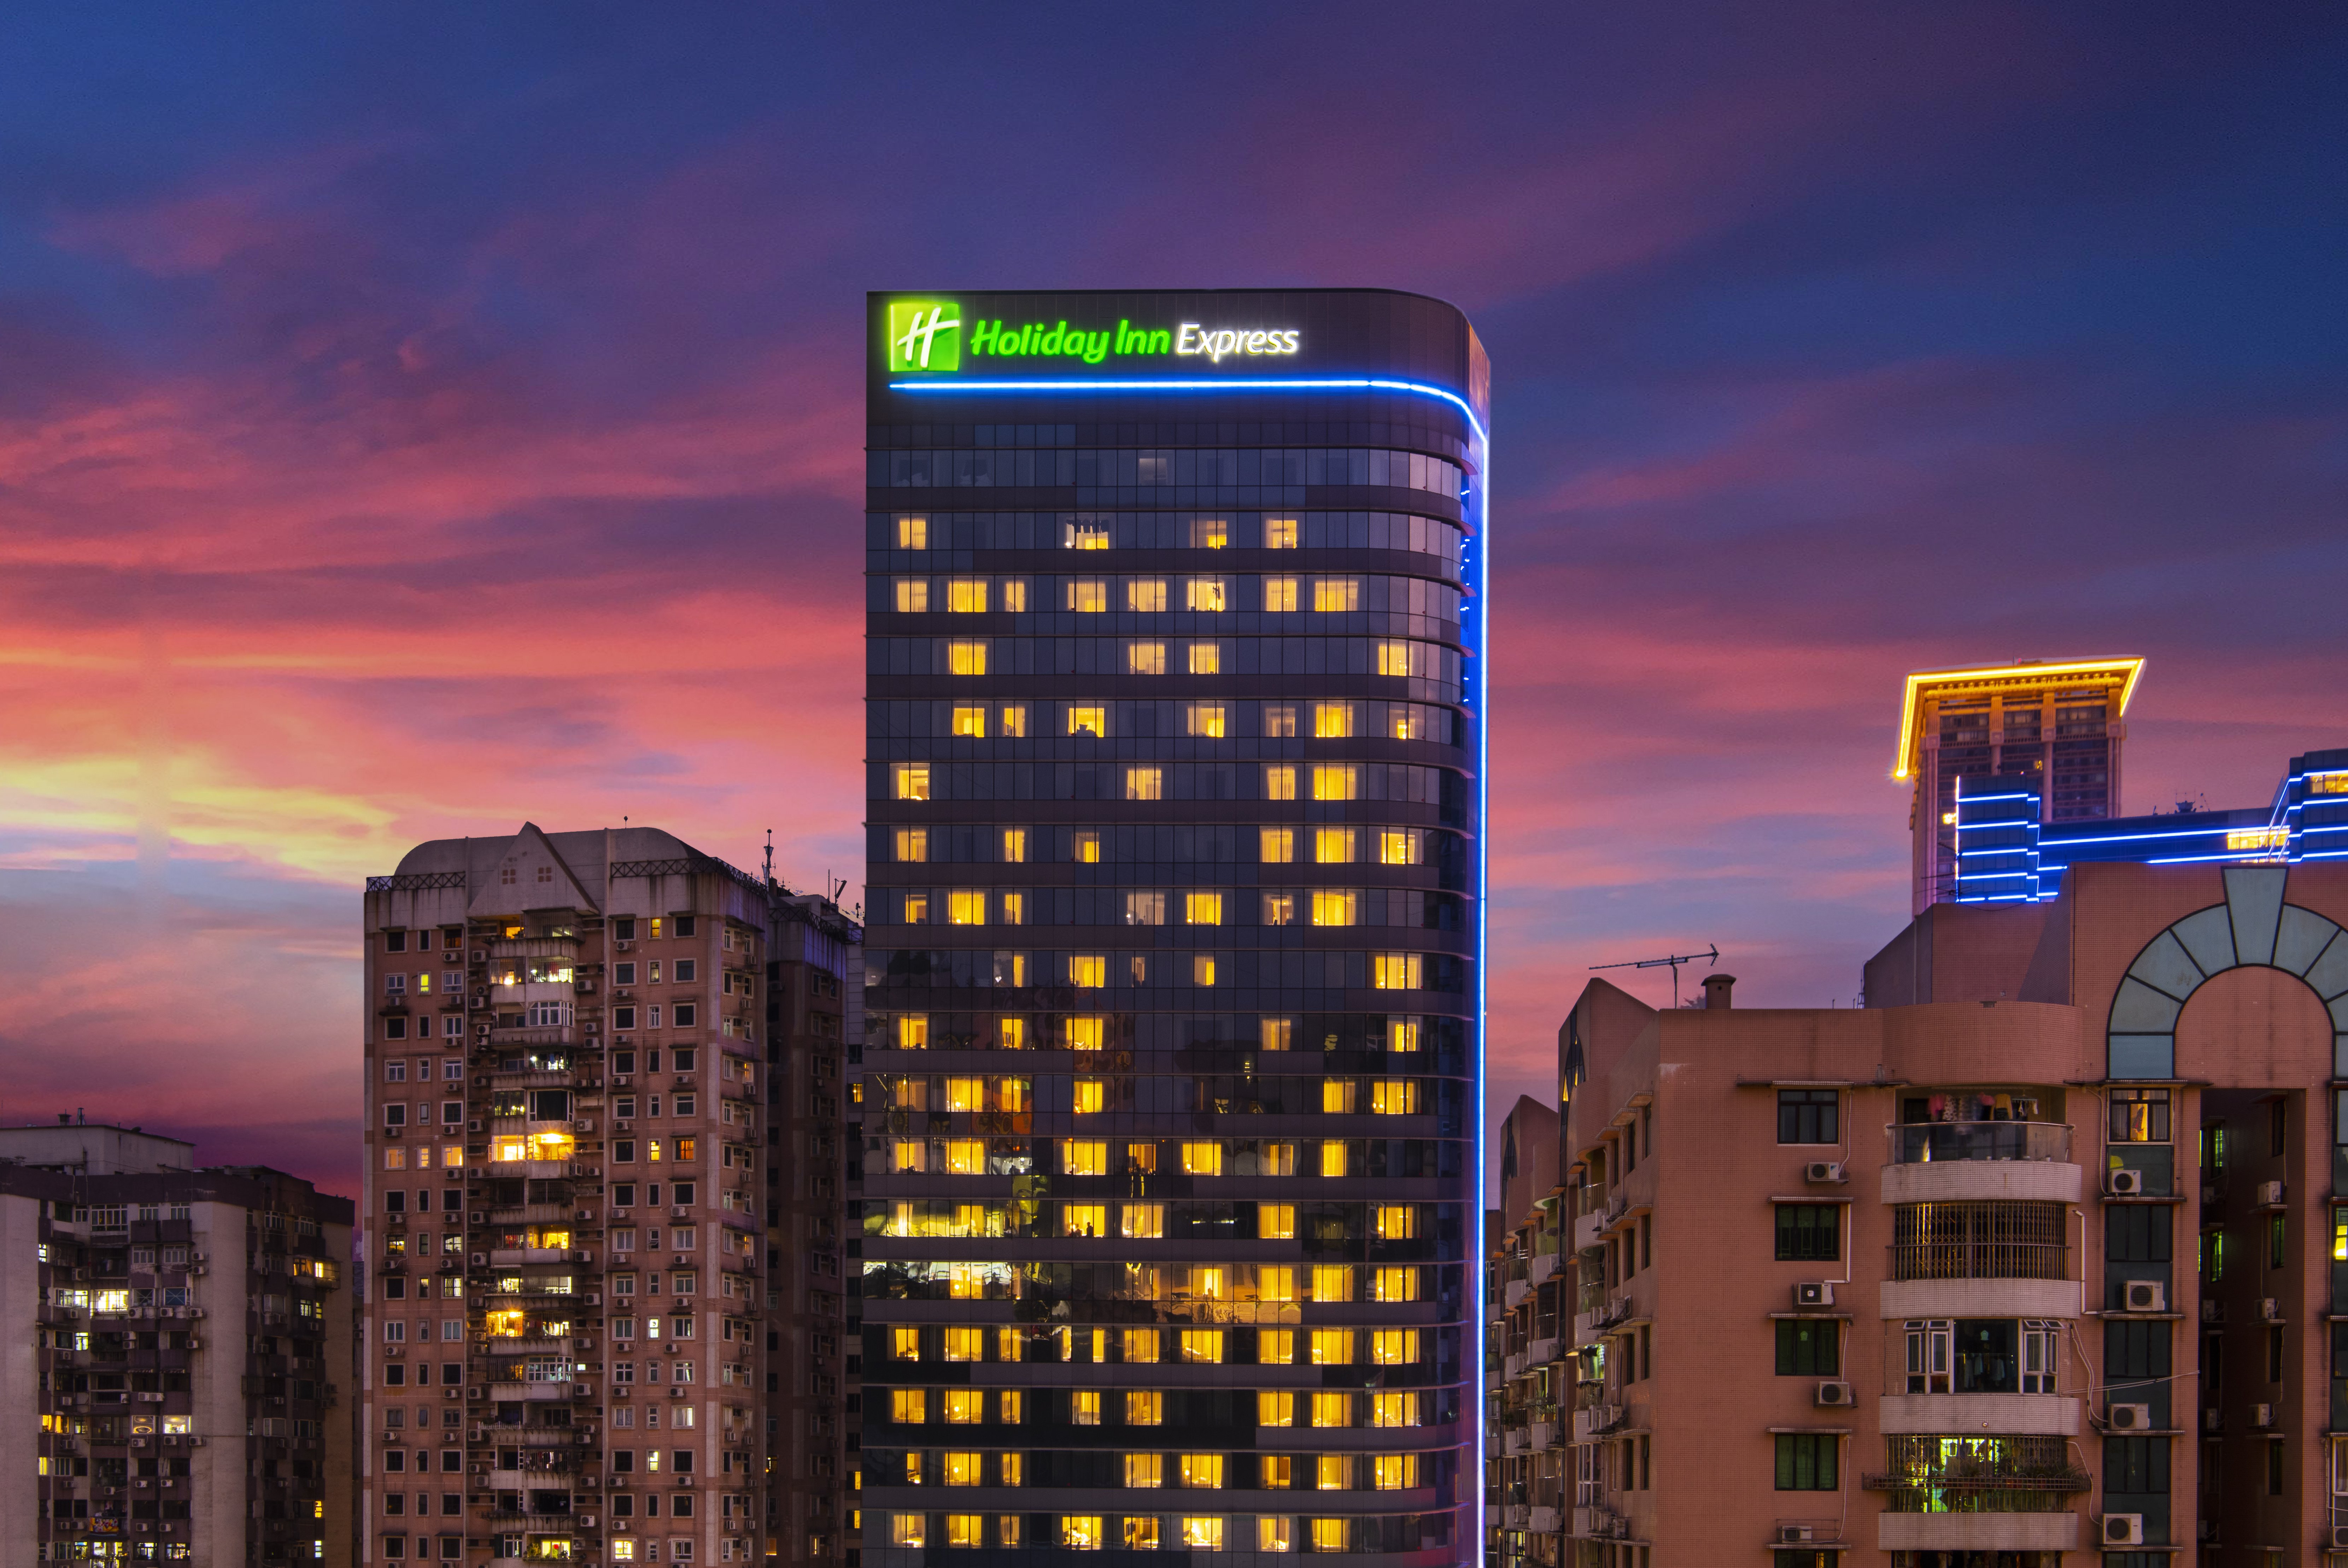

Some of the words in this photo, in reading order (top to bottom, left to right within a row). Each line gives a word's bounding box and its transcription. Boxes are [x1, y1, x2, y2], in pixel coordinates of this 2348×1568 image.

[970, 320, 1109, 363] Holiday
[1115, 320, 1170, 354] Inn
[1175, 323, 1299, 363] Express
